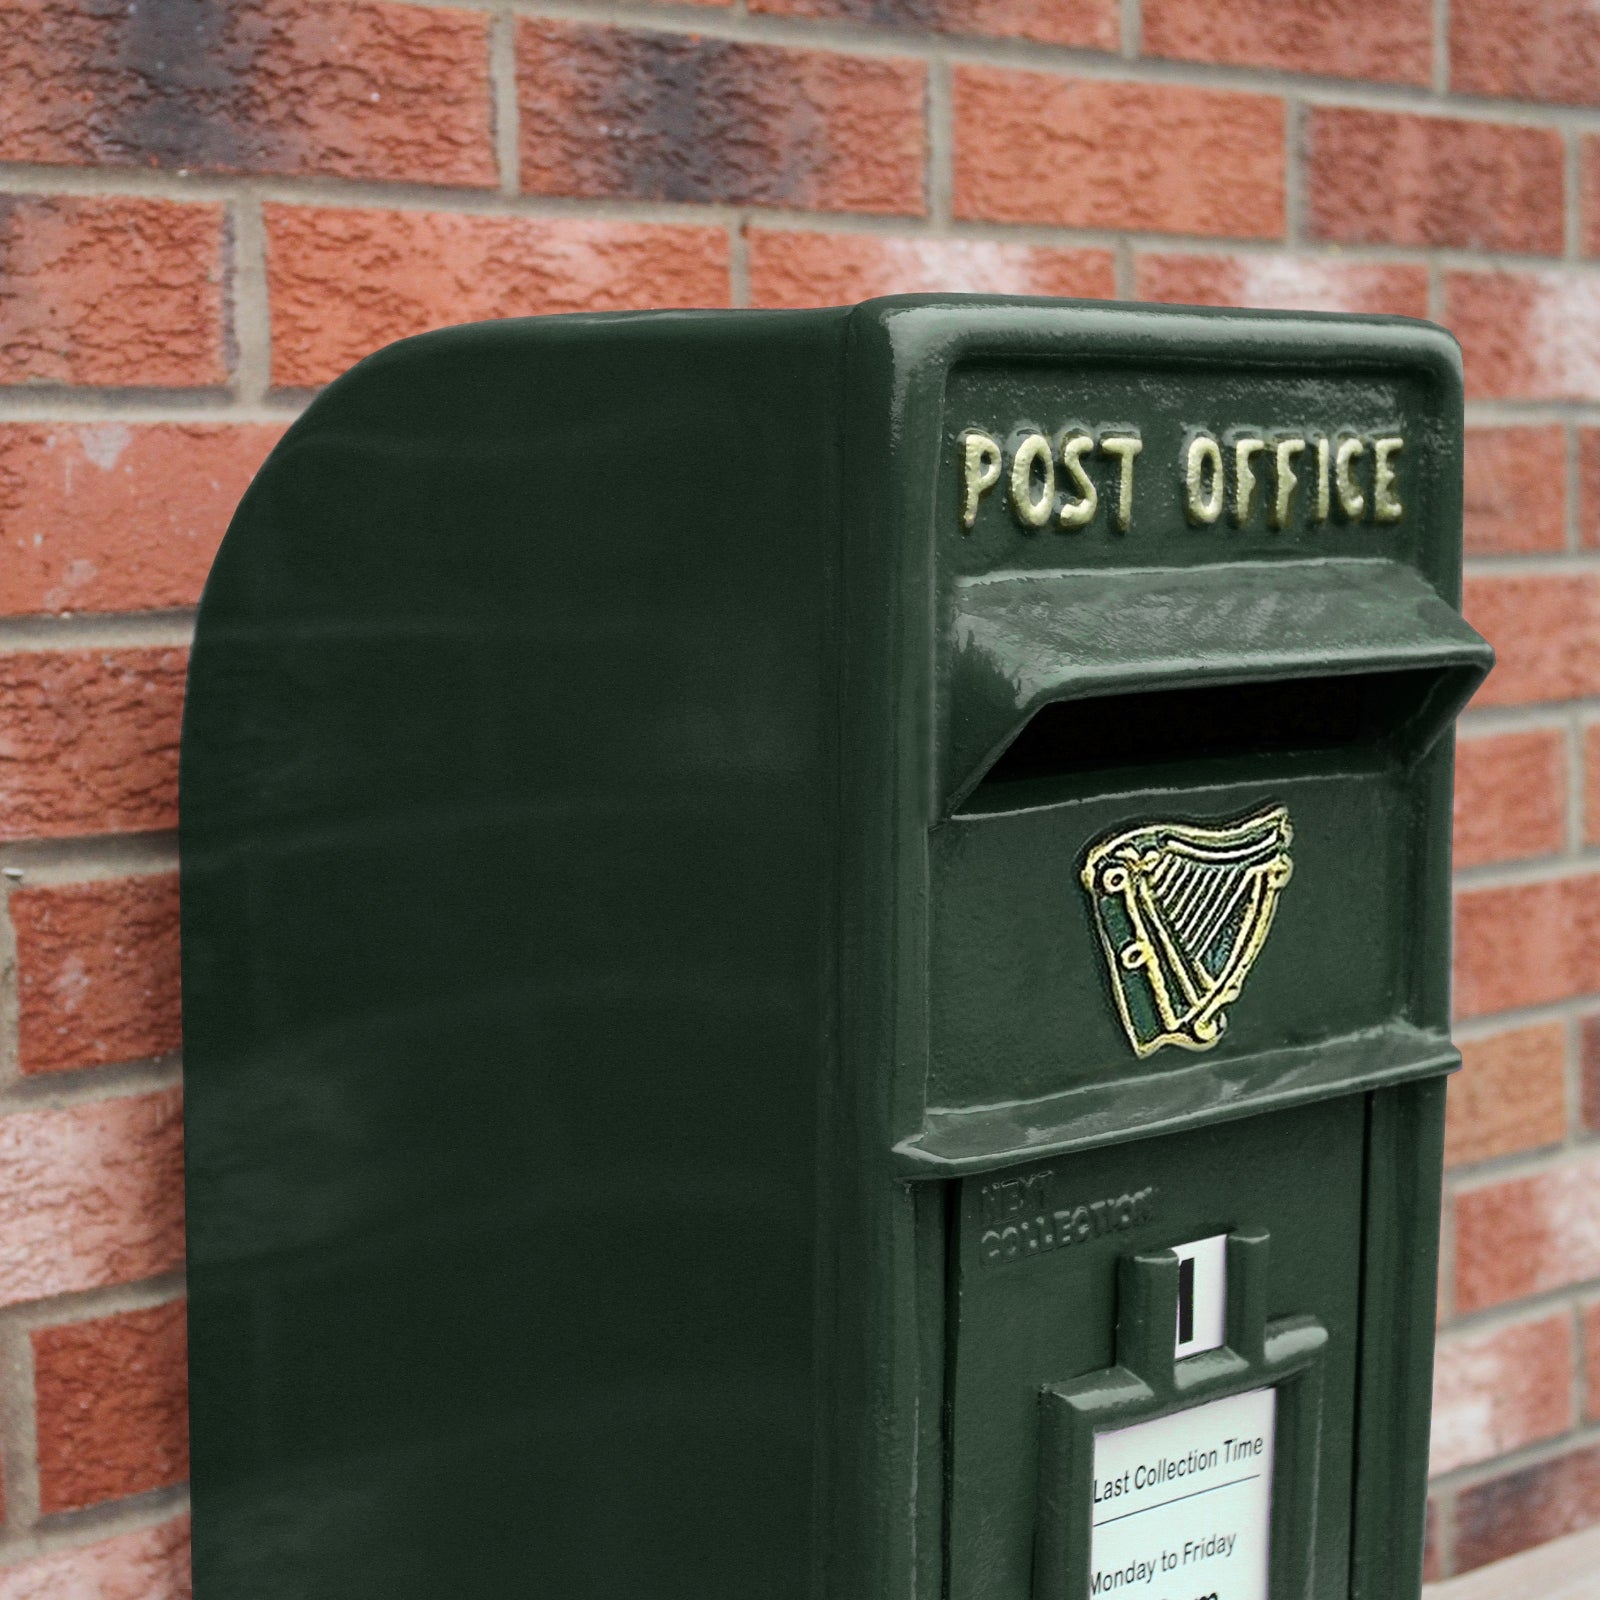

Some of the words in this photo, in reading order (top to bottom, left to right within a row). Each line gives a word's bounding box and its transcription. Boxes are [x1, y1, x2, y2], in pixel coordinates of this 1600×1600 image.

[963, 432, 1143, 532] POST
[1186, 435, 1404, 530] OFFICE
[1092, 1470, 1130, 1504] Last
[1134, 1448, 1218, 1490] Collection
[1223, 1437, 1264, 1464] Time
[1090, 1560, 1157, 1596] Monday
[1161, 1550, 1178, 1573] to
[1182, 1533, 1237, 1565] Friday
